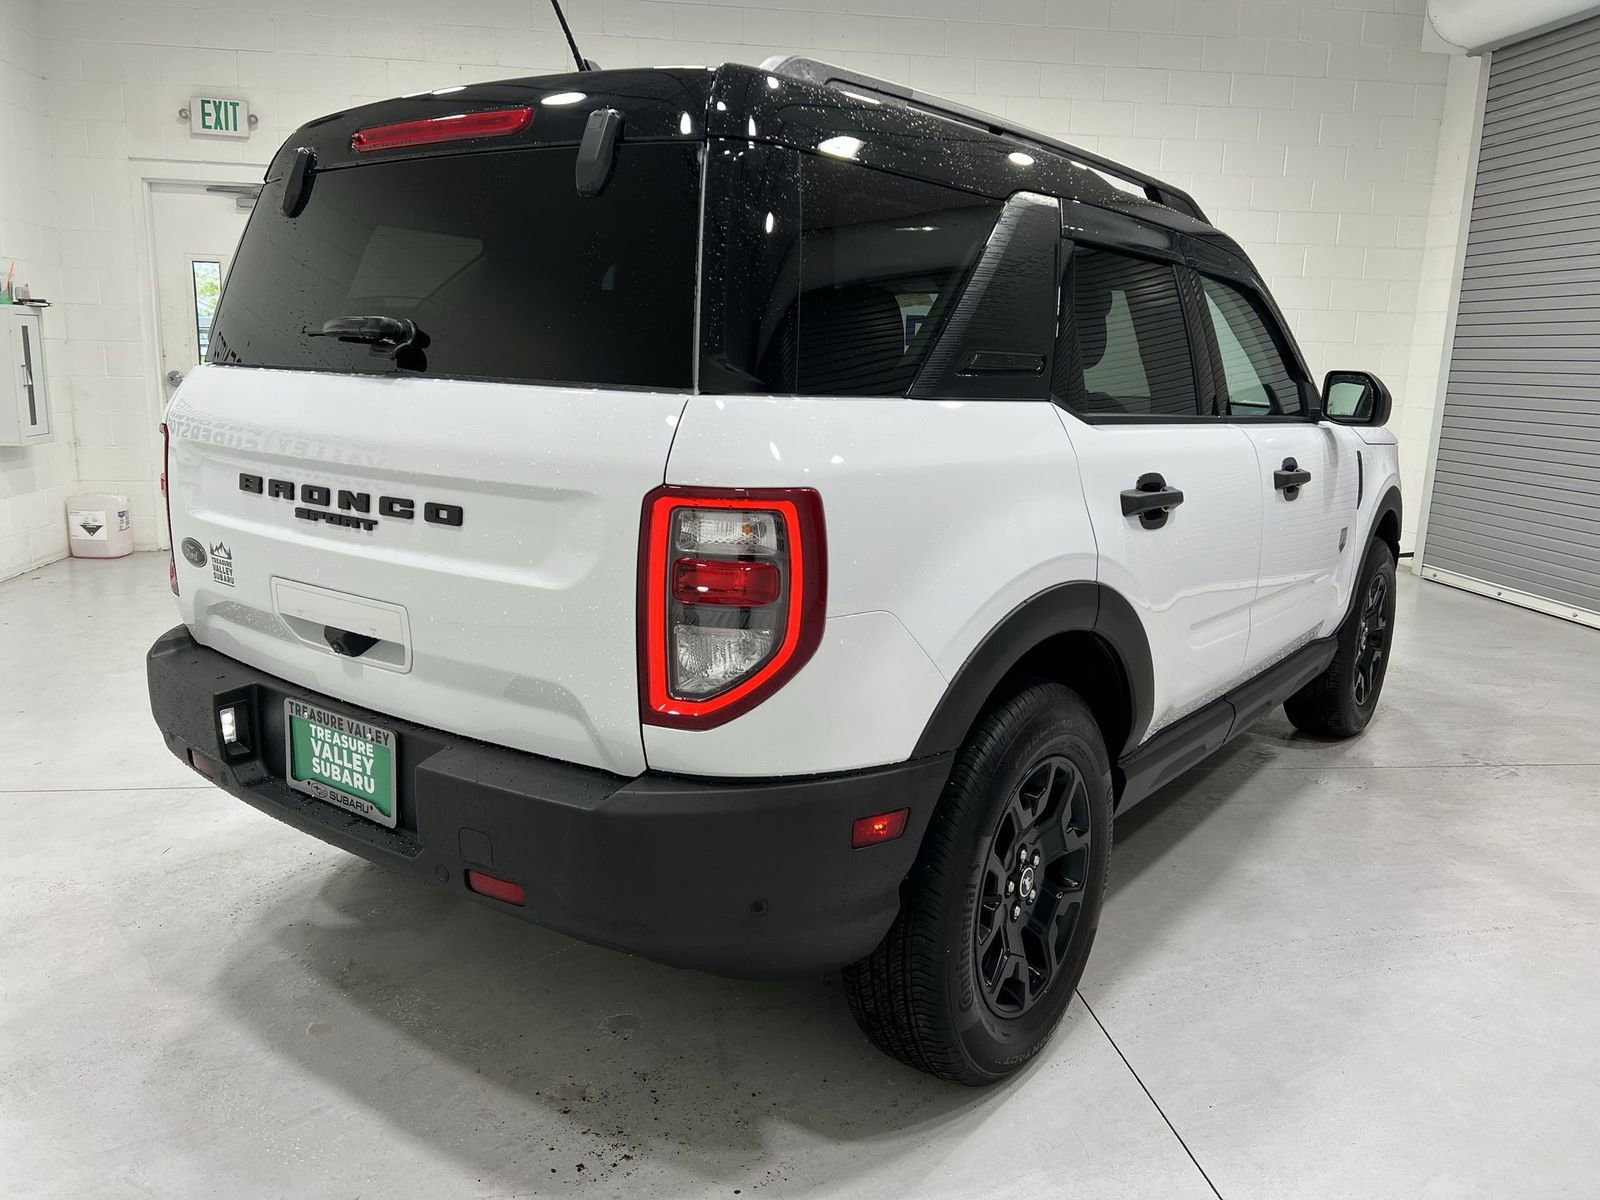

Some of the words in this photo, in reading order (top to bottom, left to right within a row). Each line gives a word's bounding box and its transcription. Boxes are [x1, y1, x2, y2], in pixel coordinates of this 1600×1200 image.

[200, 99, 240, 132] EXIT
[239, 472, 464, 526] BRONCO
[294, 506, 378, 531] SPORT
[211, 556, 233, 568] TREASURE
[212, 563, 233, 576] VALLEY
[213, 572, 235, 584] SUBARU
[288, 701, 344, 730] TREASURE
[346, 720, 390, 746] VALLEY
[309, 724, 375, 757] TREASURE
[310, 738, 375, 775] VALLEY
[311, 757, 375, 794] SUBARU
[329, 791, 370, 814] SUBARU
